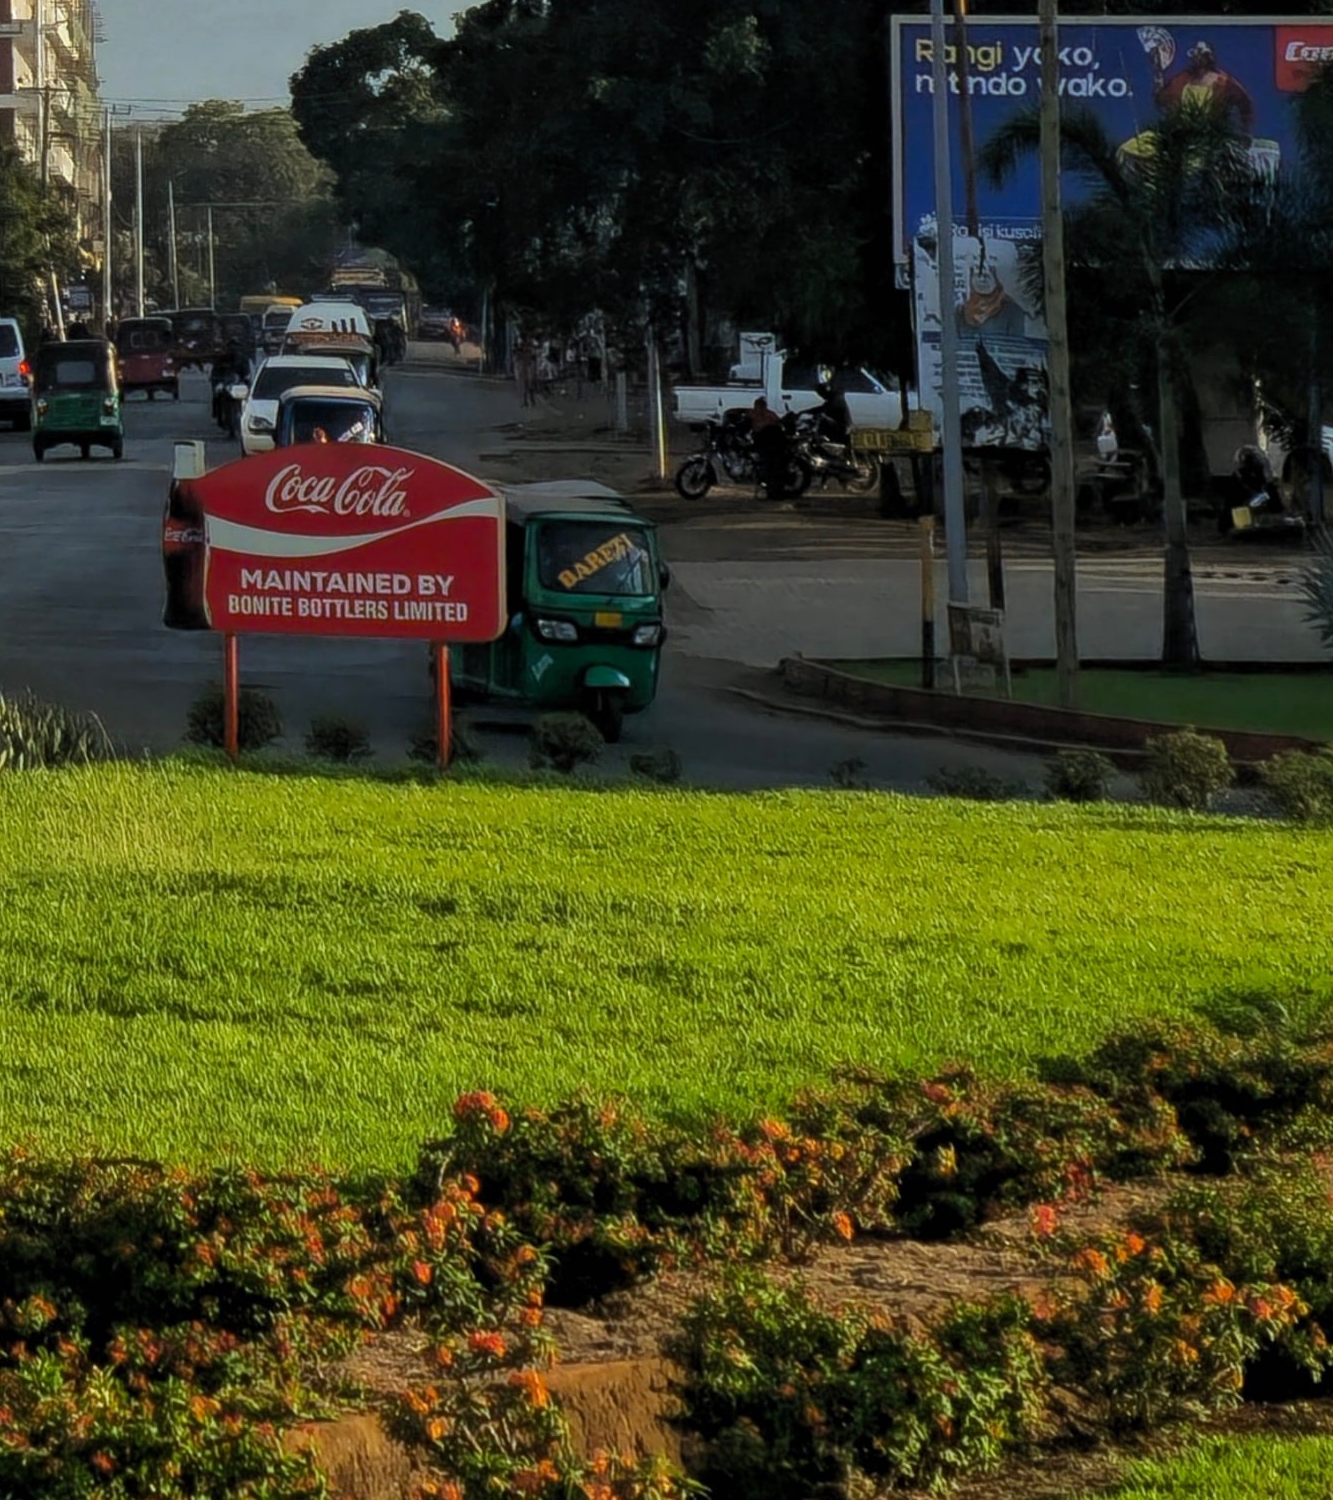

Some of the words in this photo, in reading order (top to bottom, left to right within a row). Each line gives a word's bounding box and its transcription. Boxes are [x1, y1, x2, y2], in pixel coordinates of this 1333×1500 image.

[240, 569, 411, 595] MAINTAINED
[418, 574, 455, 596] BY
[228, 595, 292, 617] BONITE
[298, 598, 388, 620] BOTTLERS
[394, 601, 467, 622] LIMITED
